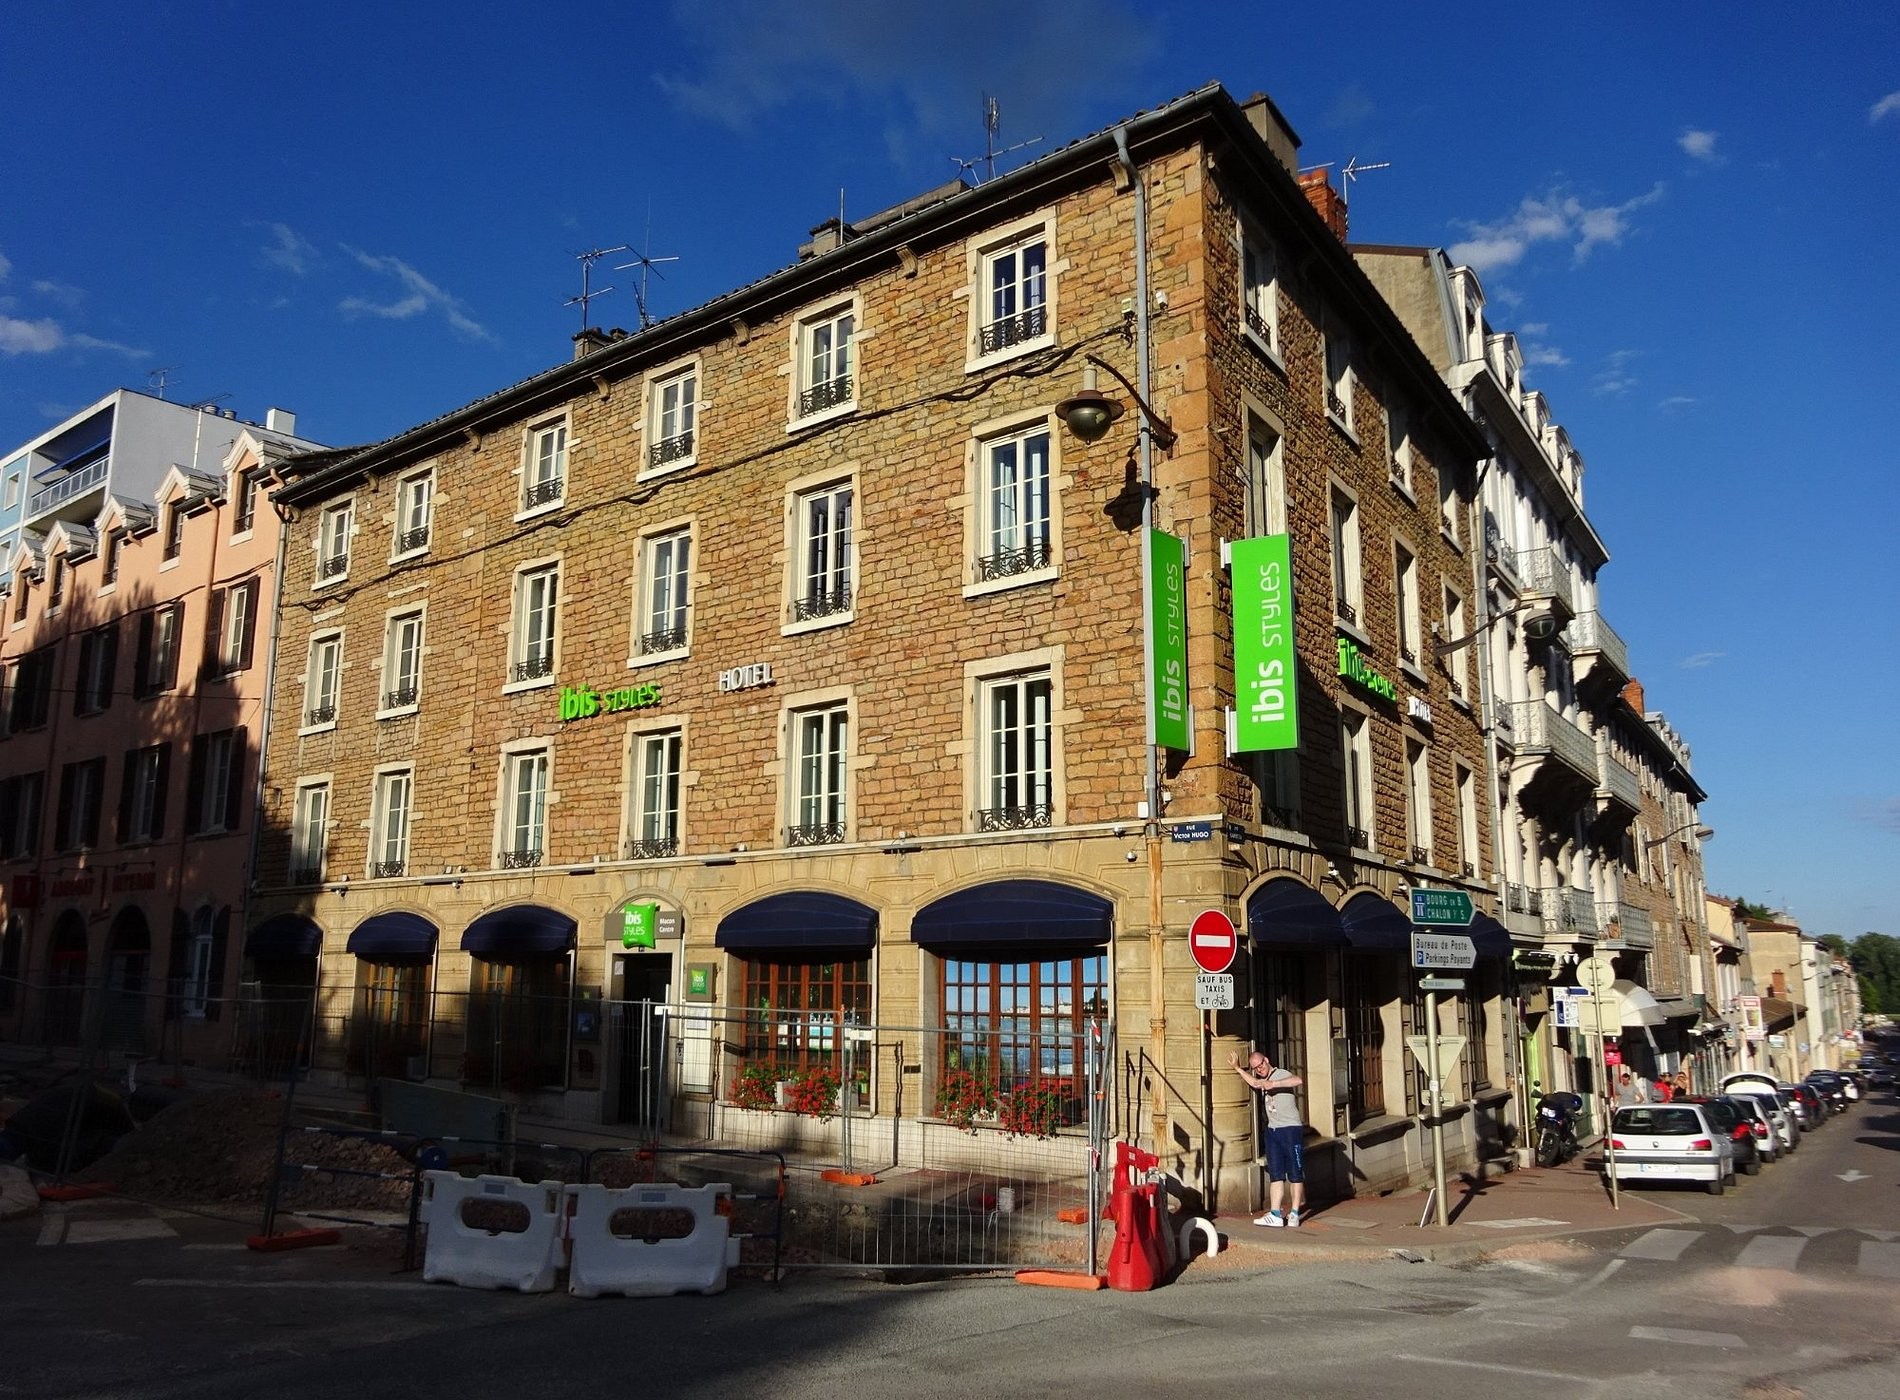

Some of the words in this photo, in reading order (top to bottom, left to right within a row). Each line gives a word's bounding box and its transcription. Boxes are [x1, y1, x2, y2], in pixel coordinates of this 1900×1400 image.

[1167, 562, 1179, 647] STYLES
[1260, 562, 1282, 647] STYLES
[719, 662, 775, 692] HOTEL
[1163, 659, 1182, 722] ibis
[1251, 659, 1285, 723] ibis
[559, 683, 600, 721] ibis
[603, 681, 662, 712] STYLES
[1426, 894, 1448, 906] BOURG
[626, 911, 642, 924] ibis
[1427, 908, 1451, 918] CHALON
[624, 926, 645, 936] STYLES
[1416, 938, 1438, 949] Bureau
[1441, 940, 1448, 950] de
[1451, 940, 1467, 950] Poste
[1426, 953, 1449, 966] Parkings
[1450, 954, 1471, 965] Payants
[1197, 976, 1216, 984] SAUF
[1219, 976, 1233, 984] BUS
[1205, 985, 1225, 993] TAXIS
[1200, 997, 1209, 1005] ET
